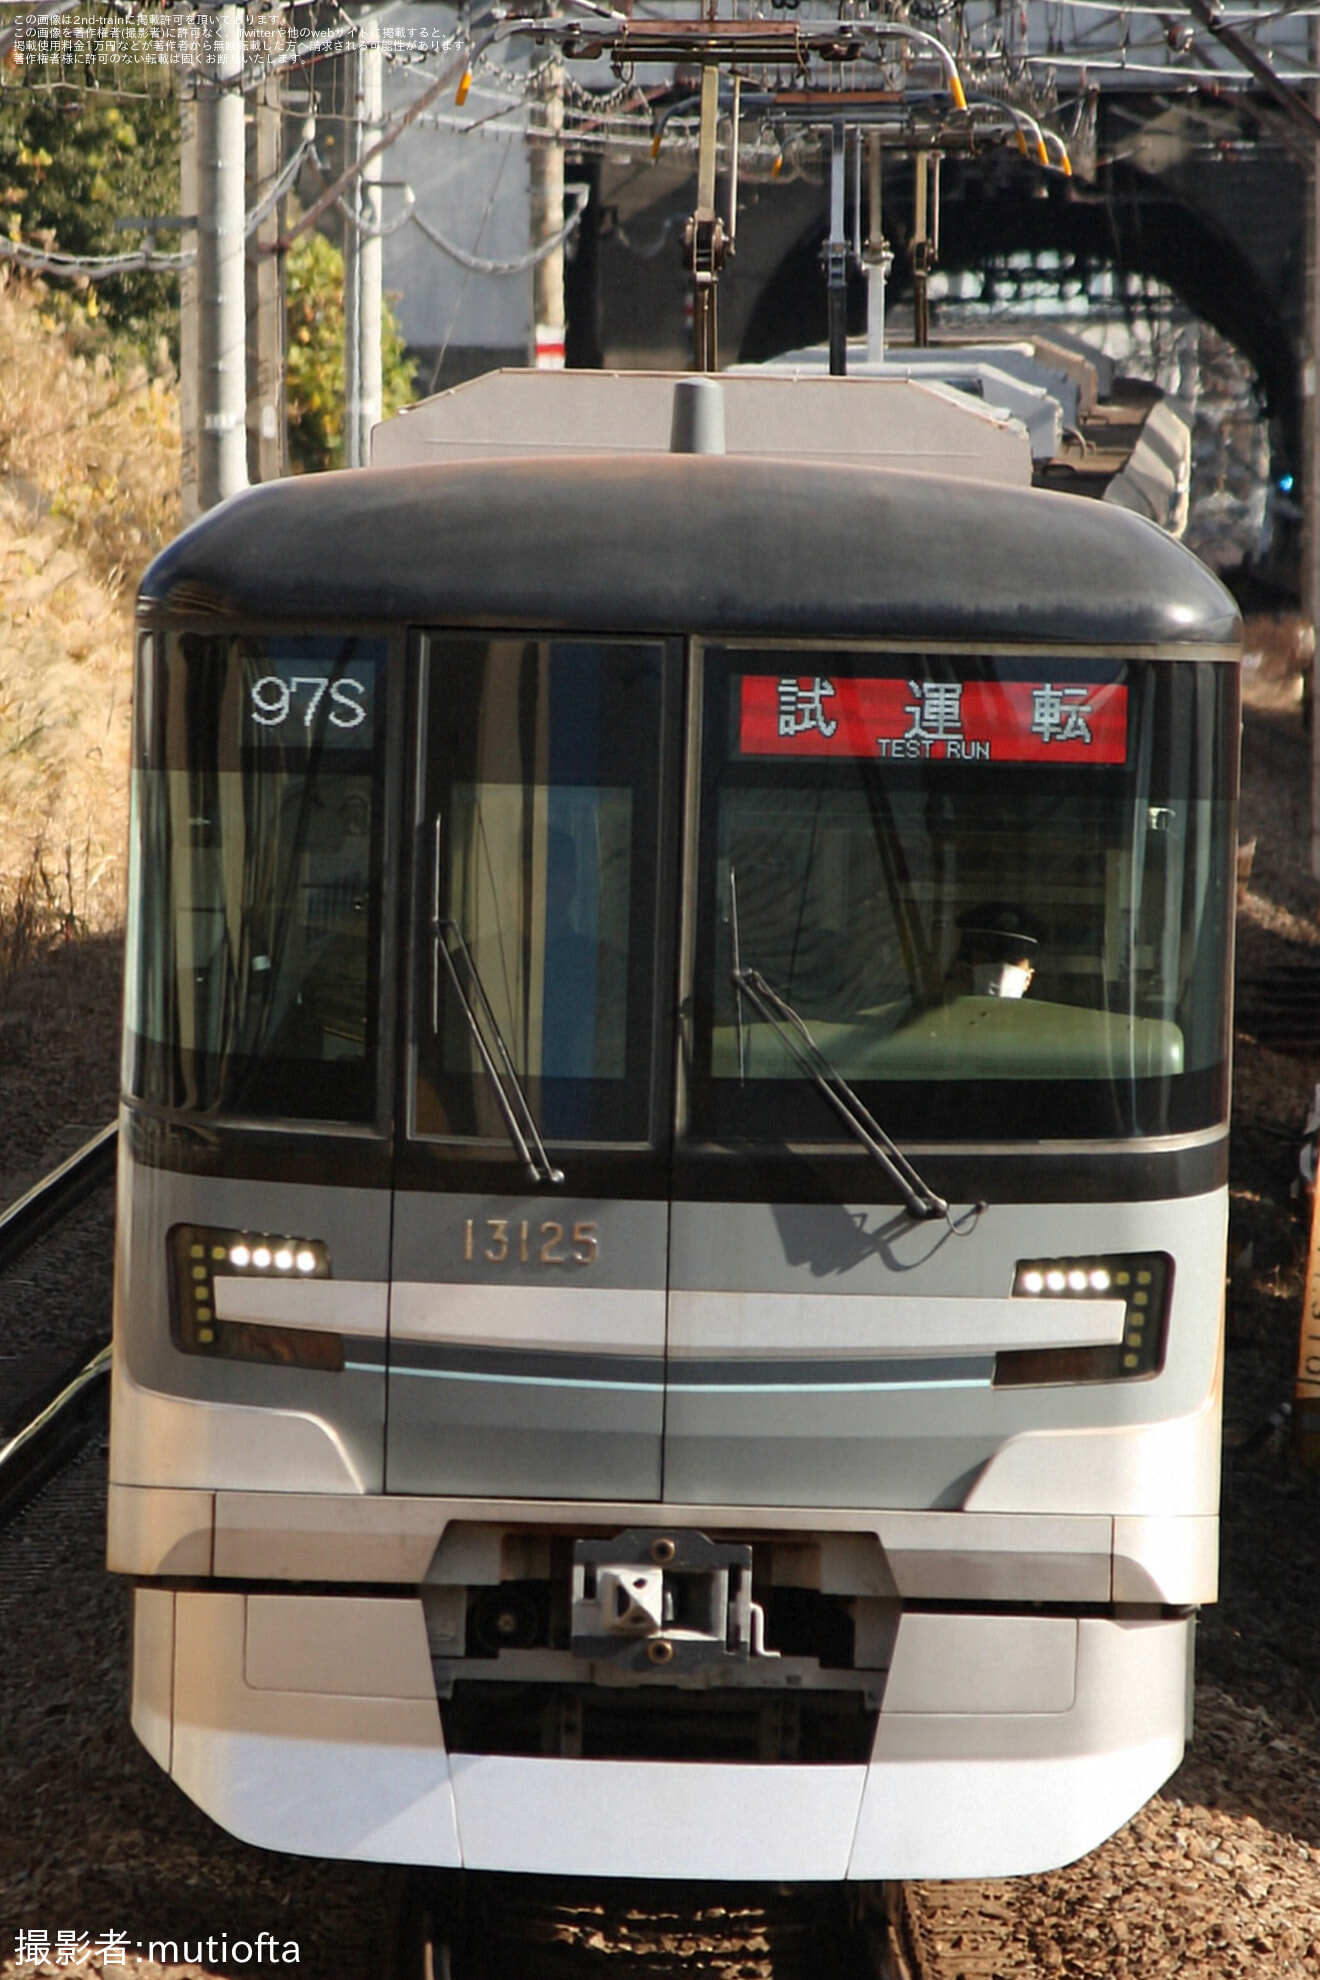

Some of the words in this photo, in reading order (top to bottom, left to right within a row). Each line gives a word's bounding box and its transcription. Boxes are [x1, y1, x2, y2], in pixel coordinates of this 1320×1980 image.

[251, 676, 366, 728] 97S
[777, 677, 1093, 744] 試運転
[877, 739, 935, 759] TEST
[946, 741, 990, 760] RUN
[465, 1219, 599, 1266] 13125
